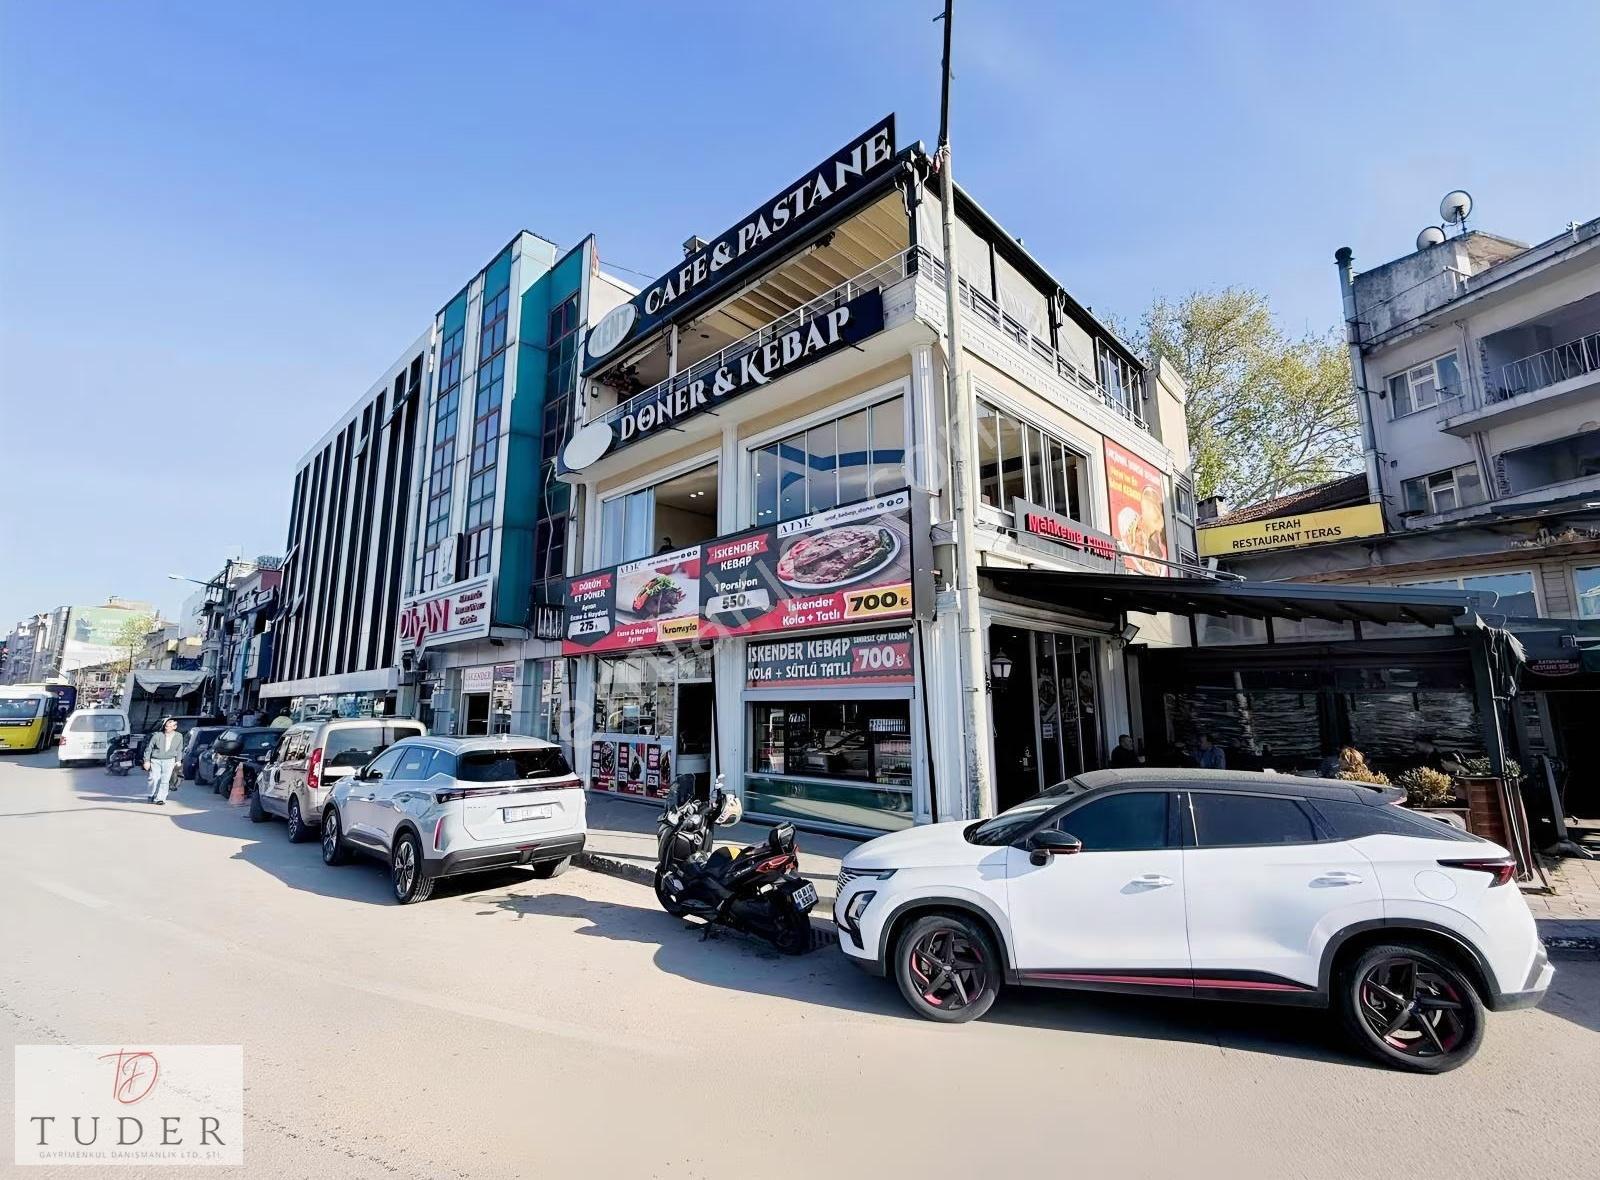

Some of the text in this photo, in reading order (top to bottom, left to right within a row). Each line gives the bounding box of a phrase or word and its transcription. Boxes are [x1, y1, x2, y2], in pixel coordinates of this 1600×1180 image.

[645, 127, 892, 315] CAFE & PASTANE
[713, 366, 736, 396] &
[740, 306, 850, 385] KEBAP
[1265, 518, 1302, 532] FERAH
[1232, 526, 1342, 549] RESTAURANT TERAS
[714, 540, 760, 559] İSKENDER
[720, 556, 752, 572] KEBAP
[720, 578, 758, 592] Porsiyon
[788, 598, 834, 612] İskender
[782, 616, 805, 626] Kola
[747, 637, 851, 663] İSKENDER KEBAP
[747, 661, 851, 681] KOLA + SÜTLÜ TATLI
